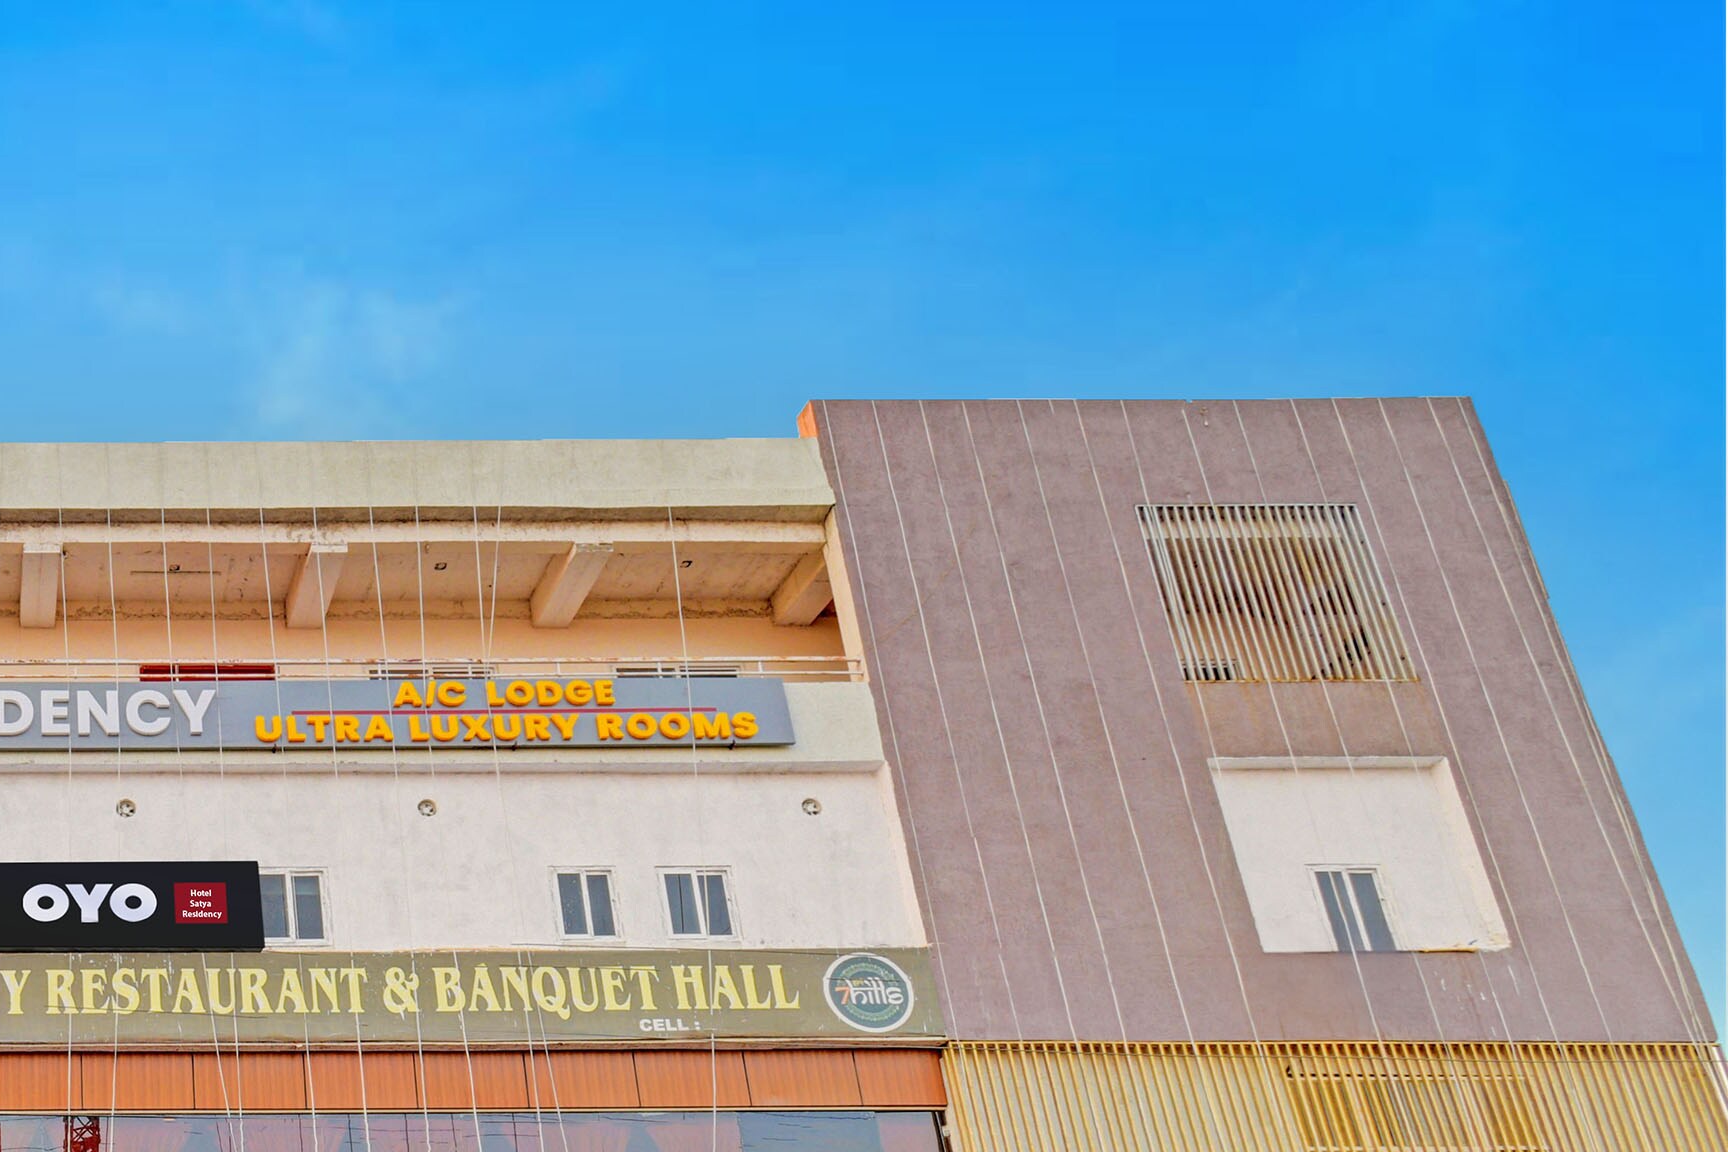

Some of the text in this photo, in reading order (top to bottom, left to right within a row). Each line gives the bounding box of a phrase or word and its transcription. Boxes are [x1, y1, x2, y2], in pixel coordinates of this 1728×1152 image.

[392, 679, 616, 708] A/C LODGE
[254, 711, 760, 744] ULTRA LUXURY ROOMS
[22, 883, 158, 924] OYO
[189, 899, 212, 909] Satya
[190, 889, 212, 897] Hotel
[182, 909, 223, 920] Residency
[44, 966, 369, 1016] RESTAURANT
[382, 966, 420, 1015] &
[431, 963, 659, 1020] BANQUET
[670, 964, 801, 1012] HALL
